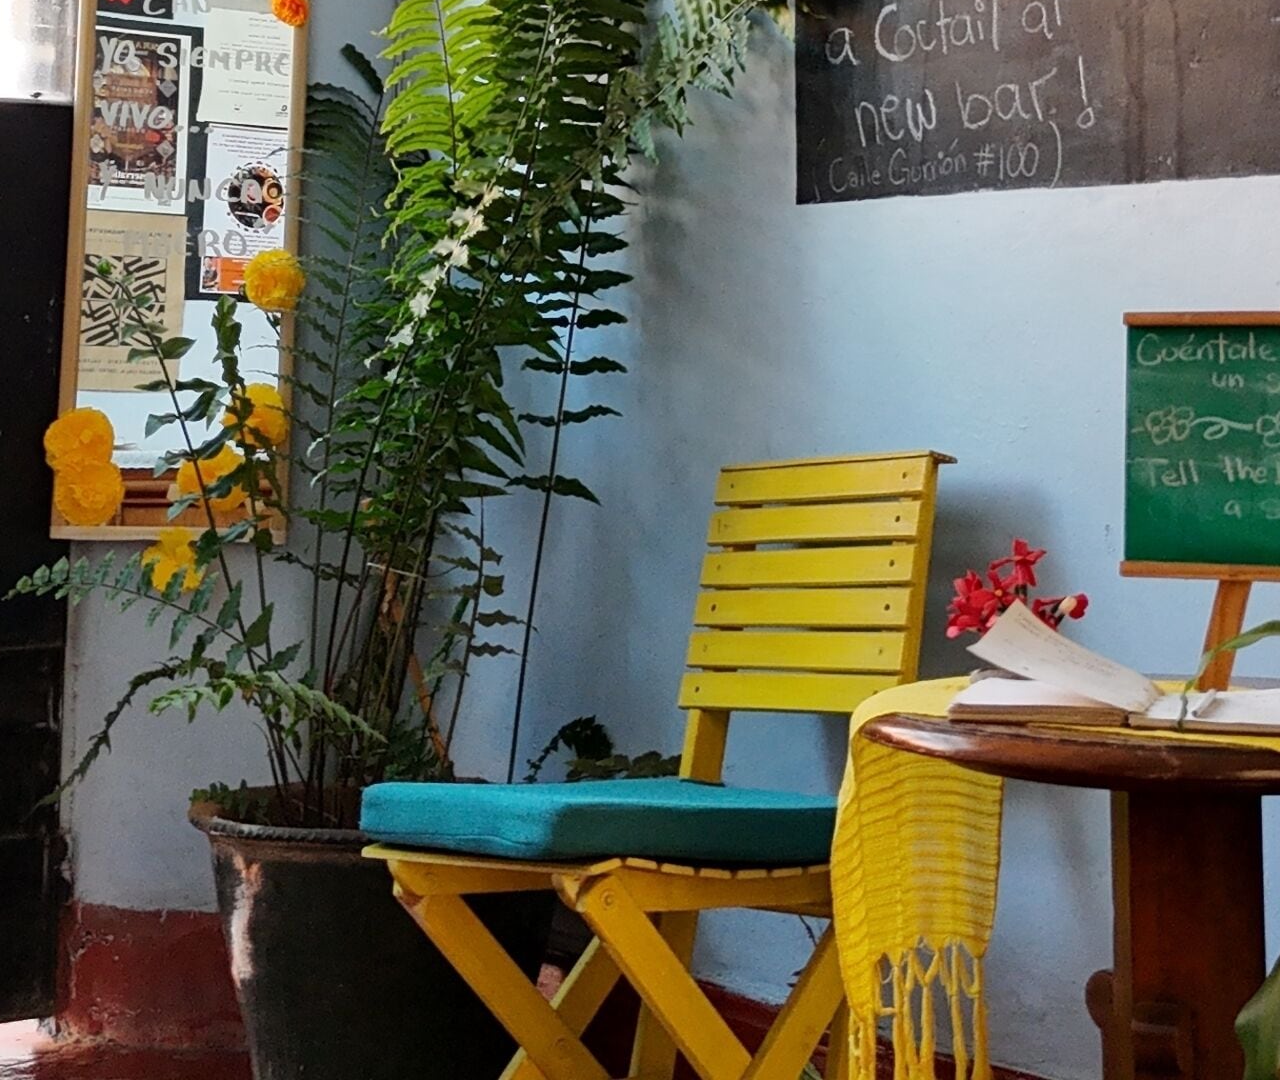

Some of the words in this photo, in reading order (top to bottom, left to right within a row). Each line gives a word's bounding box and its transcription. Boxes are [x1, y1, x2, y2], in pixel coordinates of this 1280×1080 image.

[825, 26, 859, 66] a
[854, 87, 937, 148] new
[1212, 374, 1245, 389] un
[1144, 458, 1200, 487] Tell
[1223, 455, 1268, 483] the
